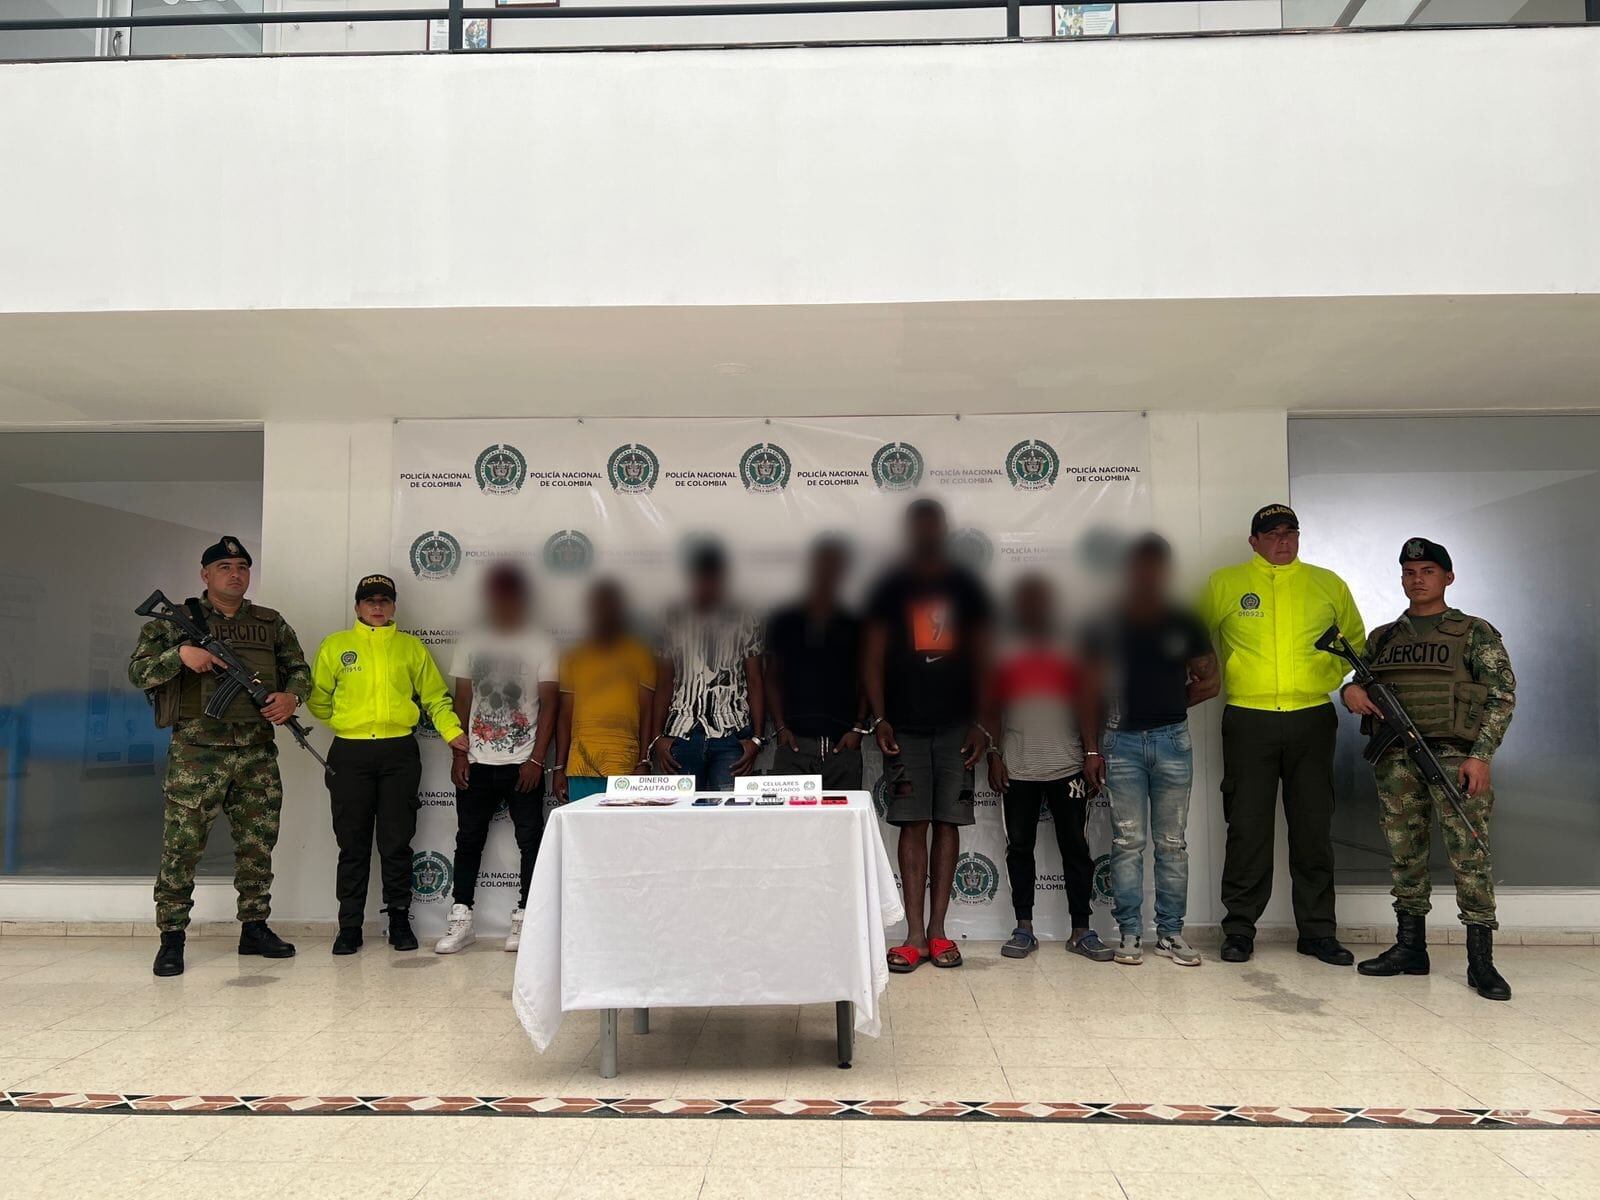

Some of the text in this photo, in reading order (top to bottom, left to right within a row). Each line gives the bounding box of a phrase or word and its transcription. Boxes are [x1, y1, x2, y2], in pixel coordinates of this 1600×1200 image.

[797, 470, 828, 478] POLICÍA
[930, 468, 1003, 477] POLICÍA NACIONAL
[1066, 466, 1097, 474] POLICÍA
[400, 472, 431, 480] POLICÍA
[530, 471, 603, 479] POLICÍA NACIONAL
[213, 624, 267, 643] JERCITO
[1377, 641, 1450, 665] EJERCITO
